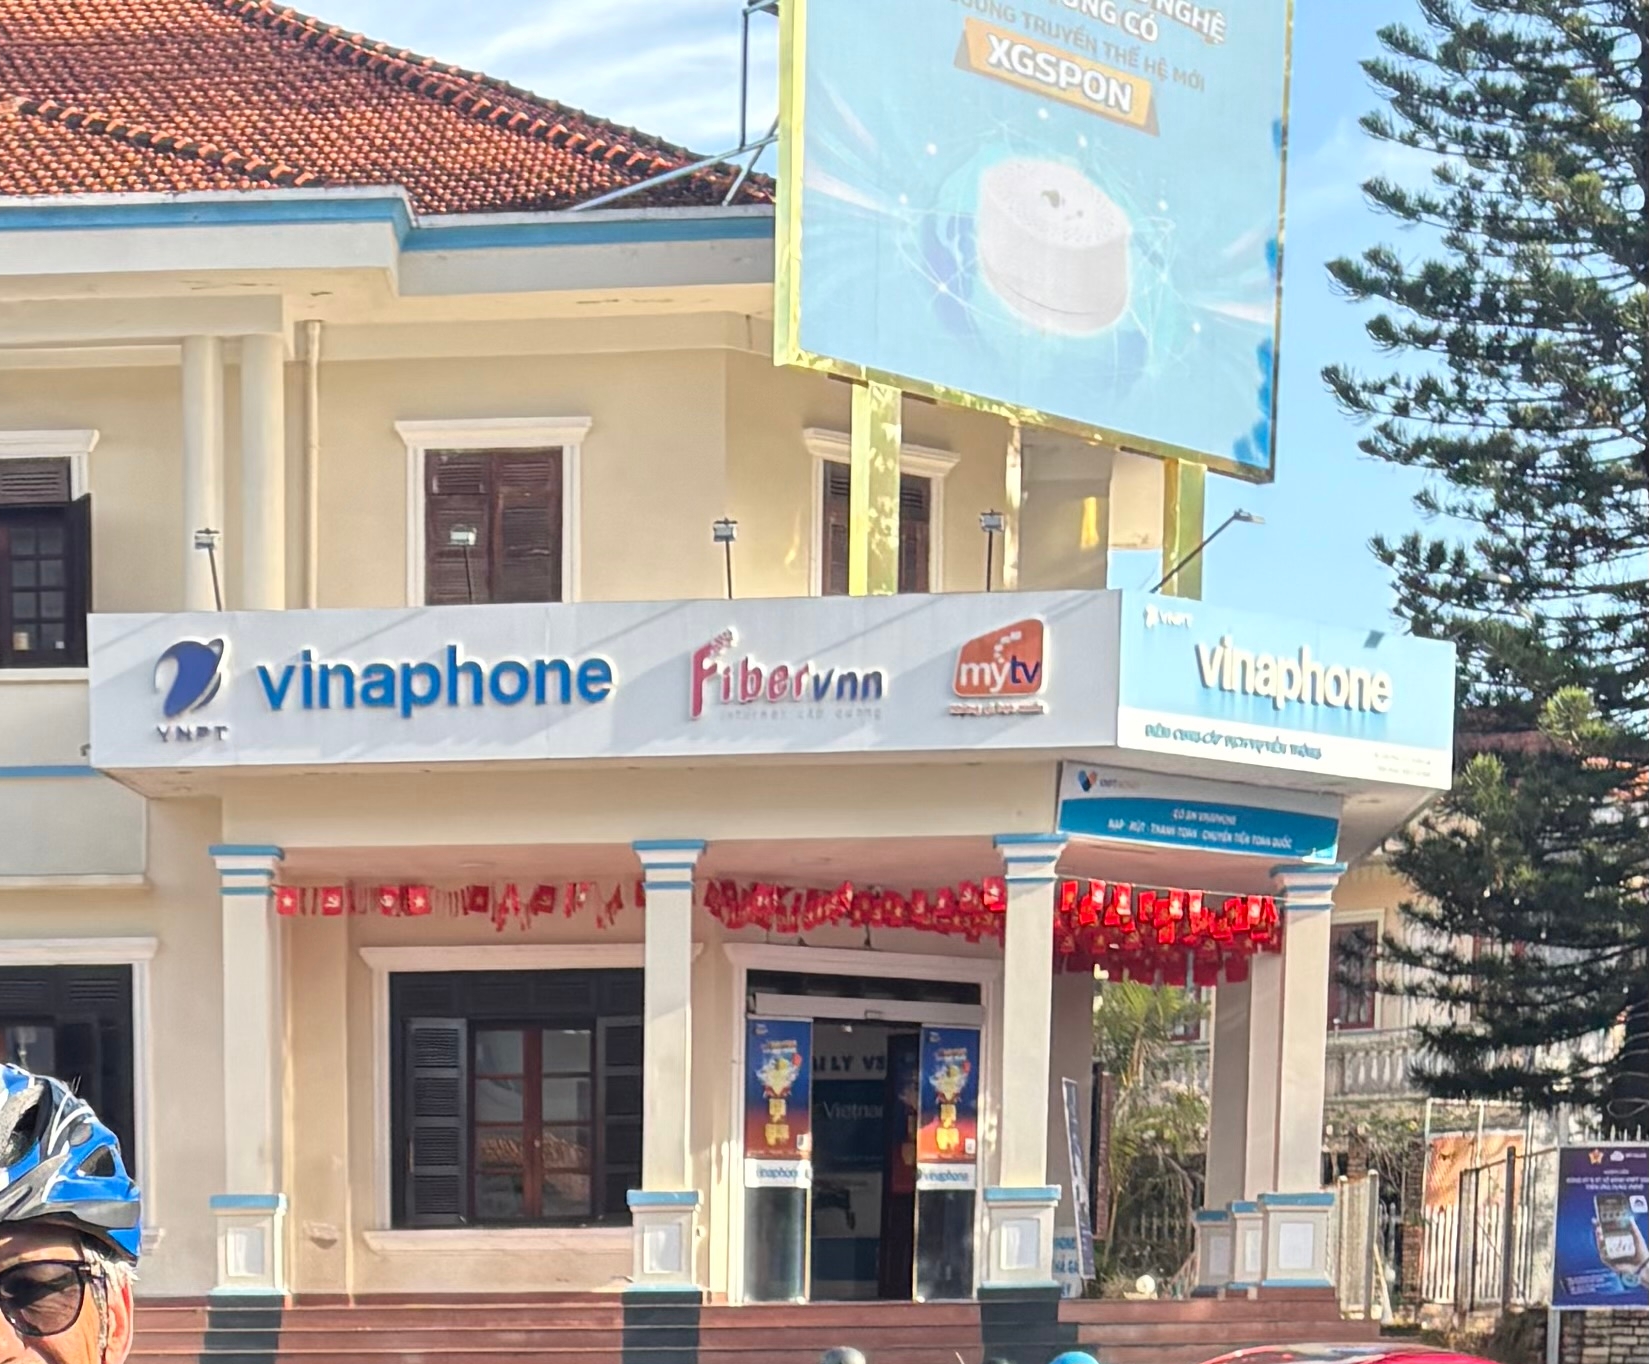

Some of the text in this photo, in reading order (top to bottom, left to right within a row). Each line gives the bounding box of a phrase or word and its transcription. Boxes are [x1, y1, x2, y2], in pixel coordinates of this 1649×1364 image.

[1123, 10, 1159, 42] CÓ
[986, 33, 1134, 113] XGSPON
[257, 645, 613, 718] vinaphone
[1195, 635, 1393, 713] vinaphone
